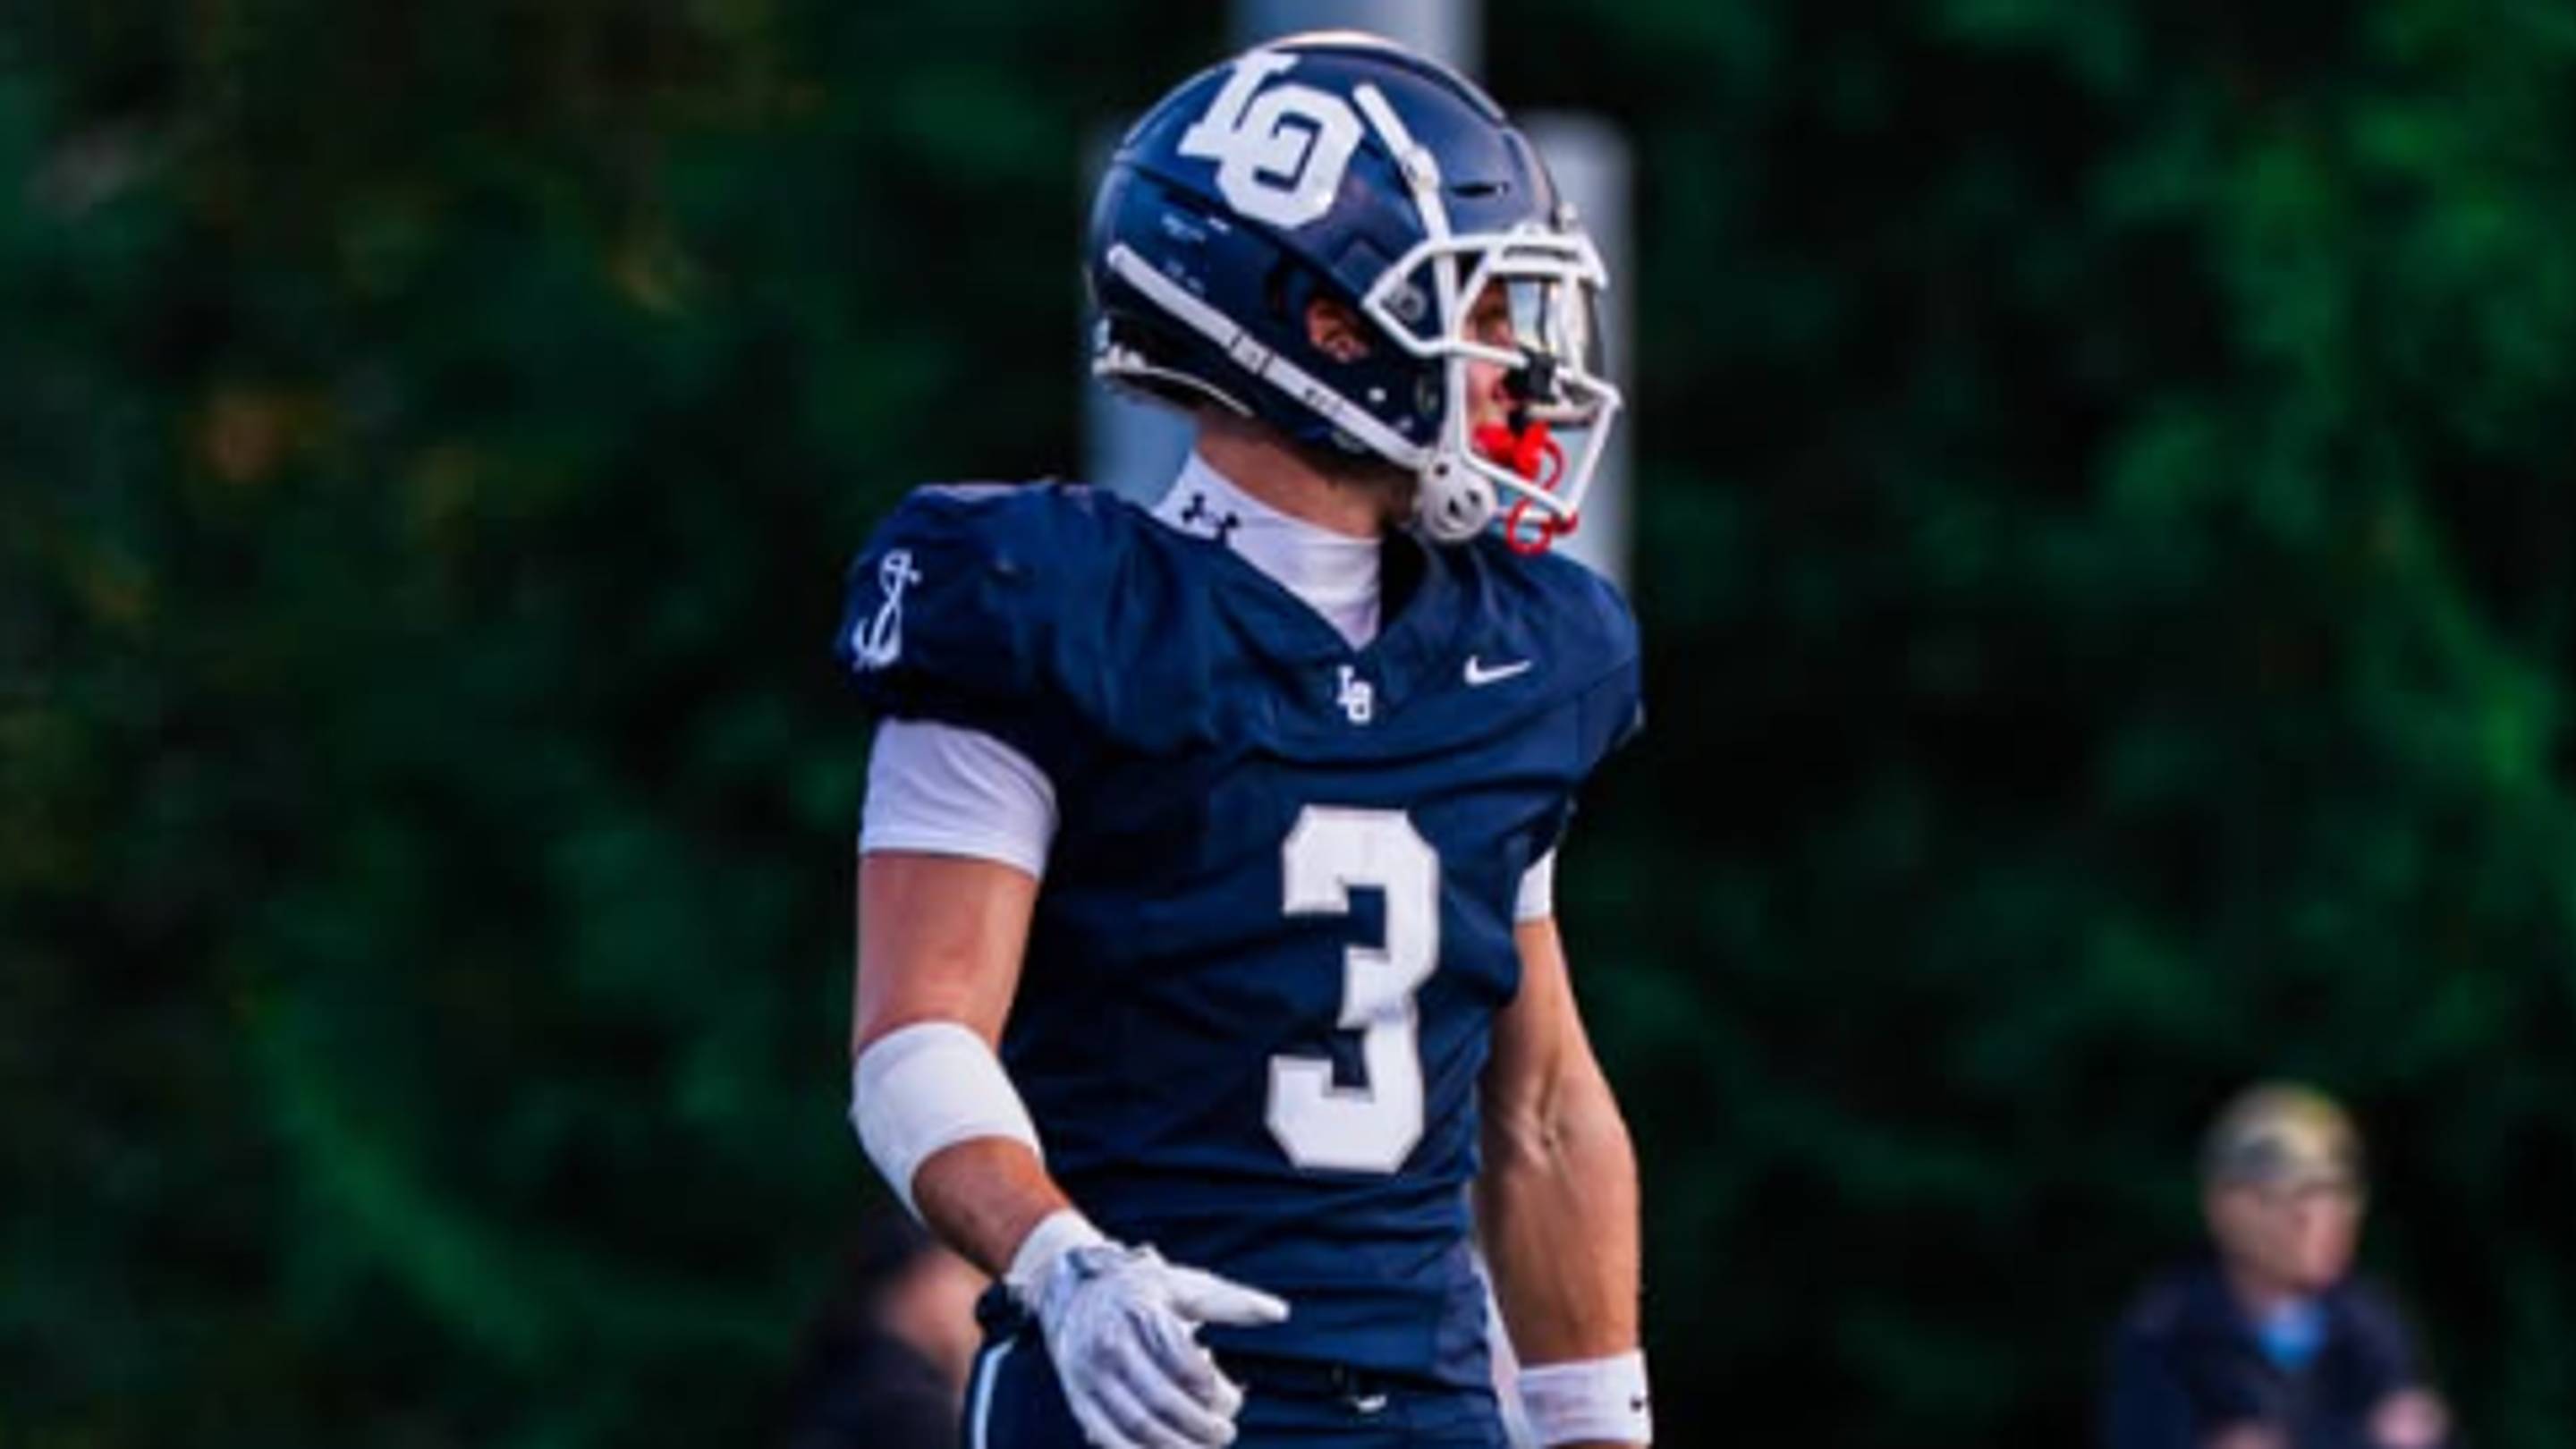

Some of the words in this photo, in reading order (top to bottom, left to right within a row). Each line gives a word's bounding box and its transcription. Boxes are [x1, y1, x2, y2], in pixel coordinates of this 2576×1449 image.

[1176, 48, 1365, 230] LO
[1336, 665, 1372, 724] LO
[1265, 804, 1440, 1174] 3
